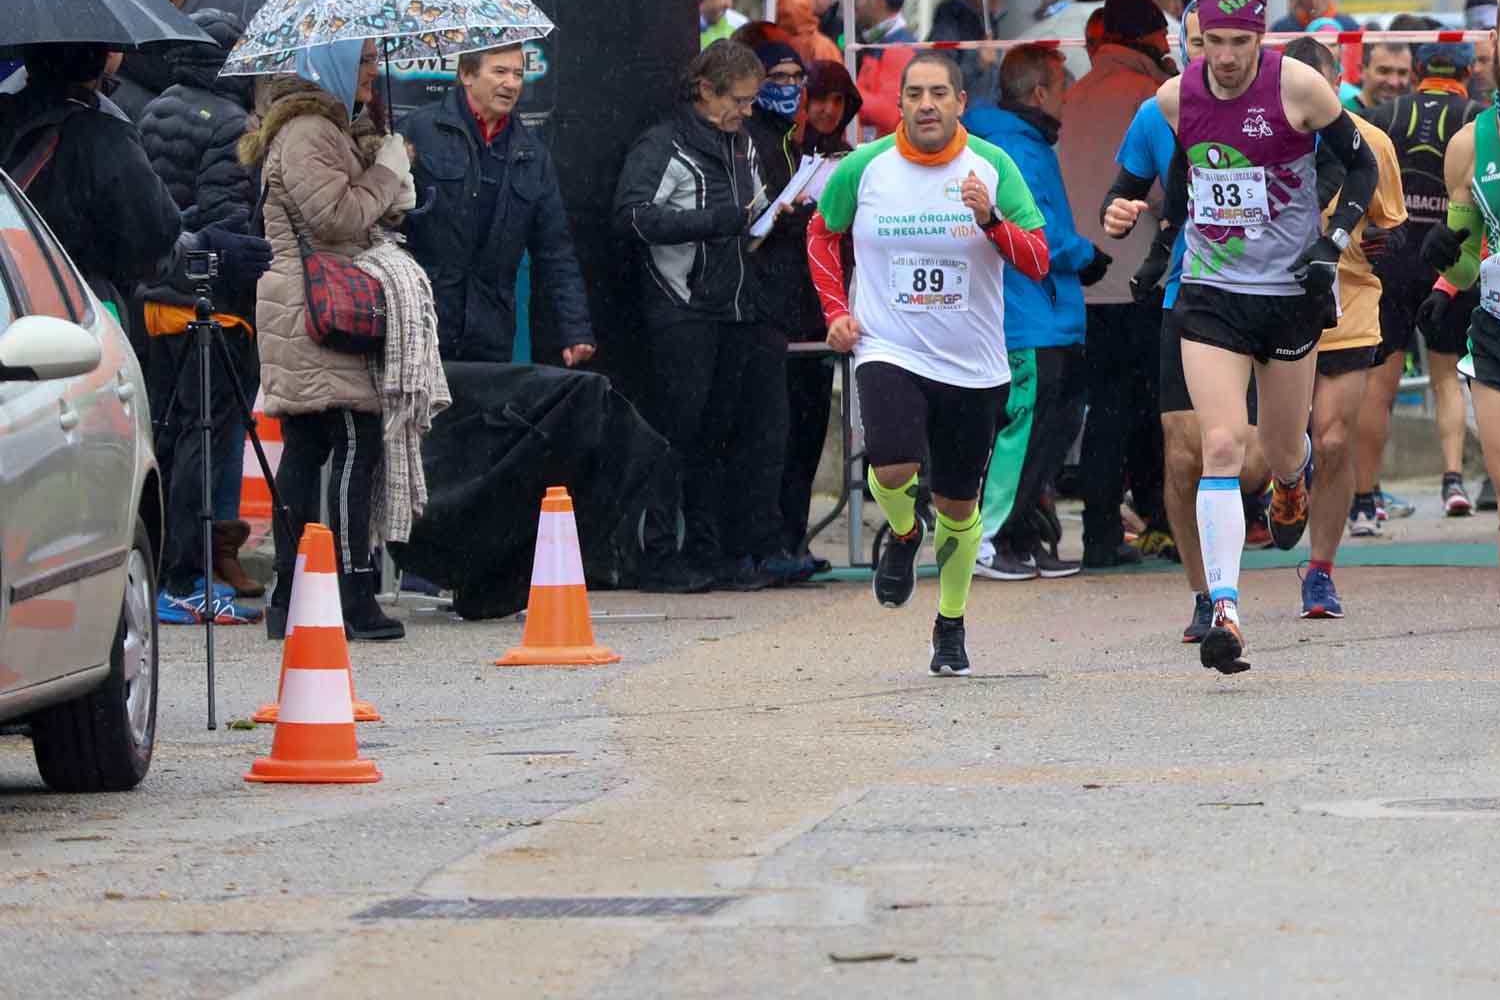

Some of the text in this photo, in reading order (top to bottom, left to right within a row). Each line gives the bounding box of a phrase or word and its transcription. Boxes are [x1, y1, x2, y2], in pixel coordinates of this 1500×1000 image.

[1211, 183, 1242, 208] 83
[1199, 206, 1265, 220] JOMISAGA
[877, 227, 890, 237] ES
[892, 226, 946, 237] REGALAR
[912, 268, 944, 293] 89
[895, 292, 963, 305] JOMISAGA
